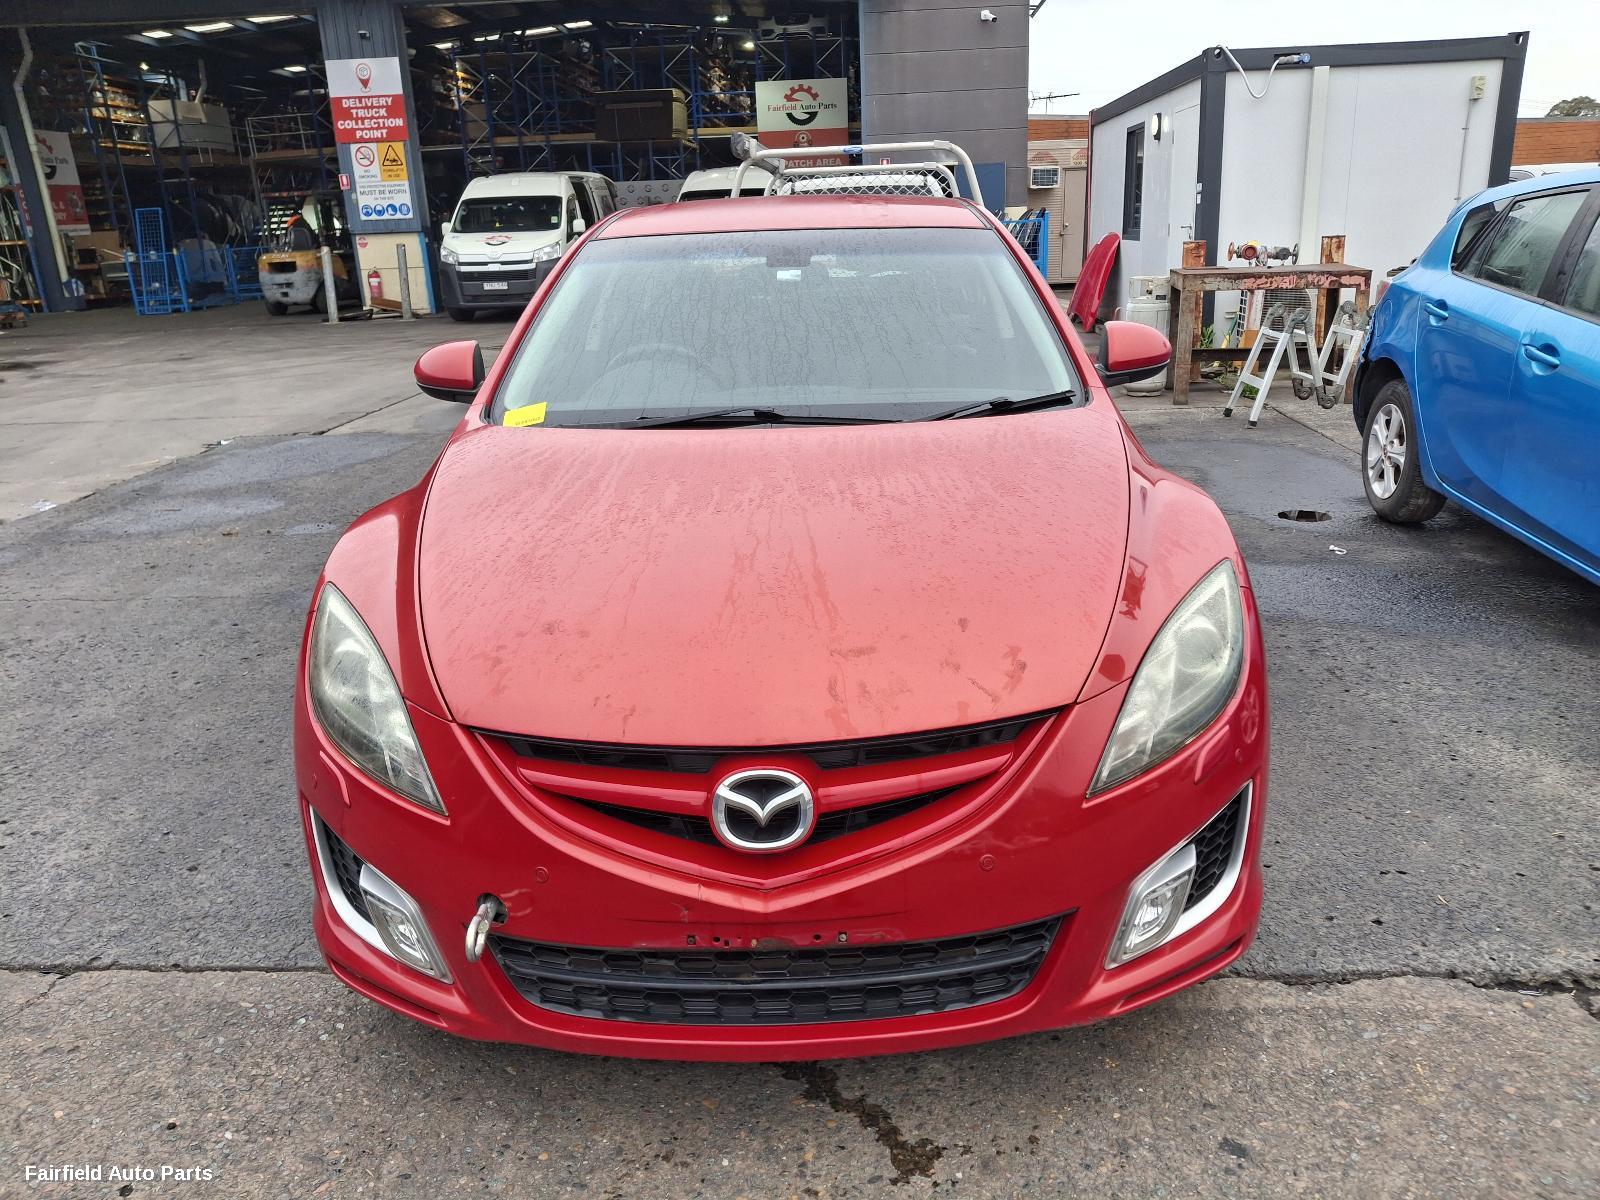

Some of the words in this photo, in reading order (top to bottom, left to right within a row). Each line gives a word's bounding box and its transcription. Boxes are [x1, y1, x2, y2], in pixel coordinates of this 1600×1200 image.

[342, 97, 392, 108] DELIVERY
[767, 103, 797, 112] Fairfield
[799, 103, 816, 111] Auto
[818, 102, 837, 110] Parts
[351, 108, 387, 117] TRUCK
[337, 118, 404, 129] COLLECTION
[355, 129, 387, 138] POINT
[816, 158, 841, 166] AREA
